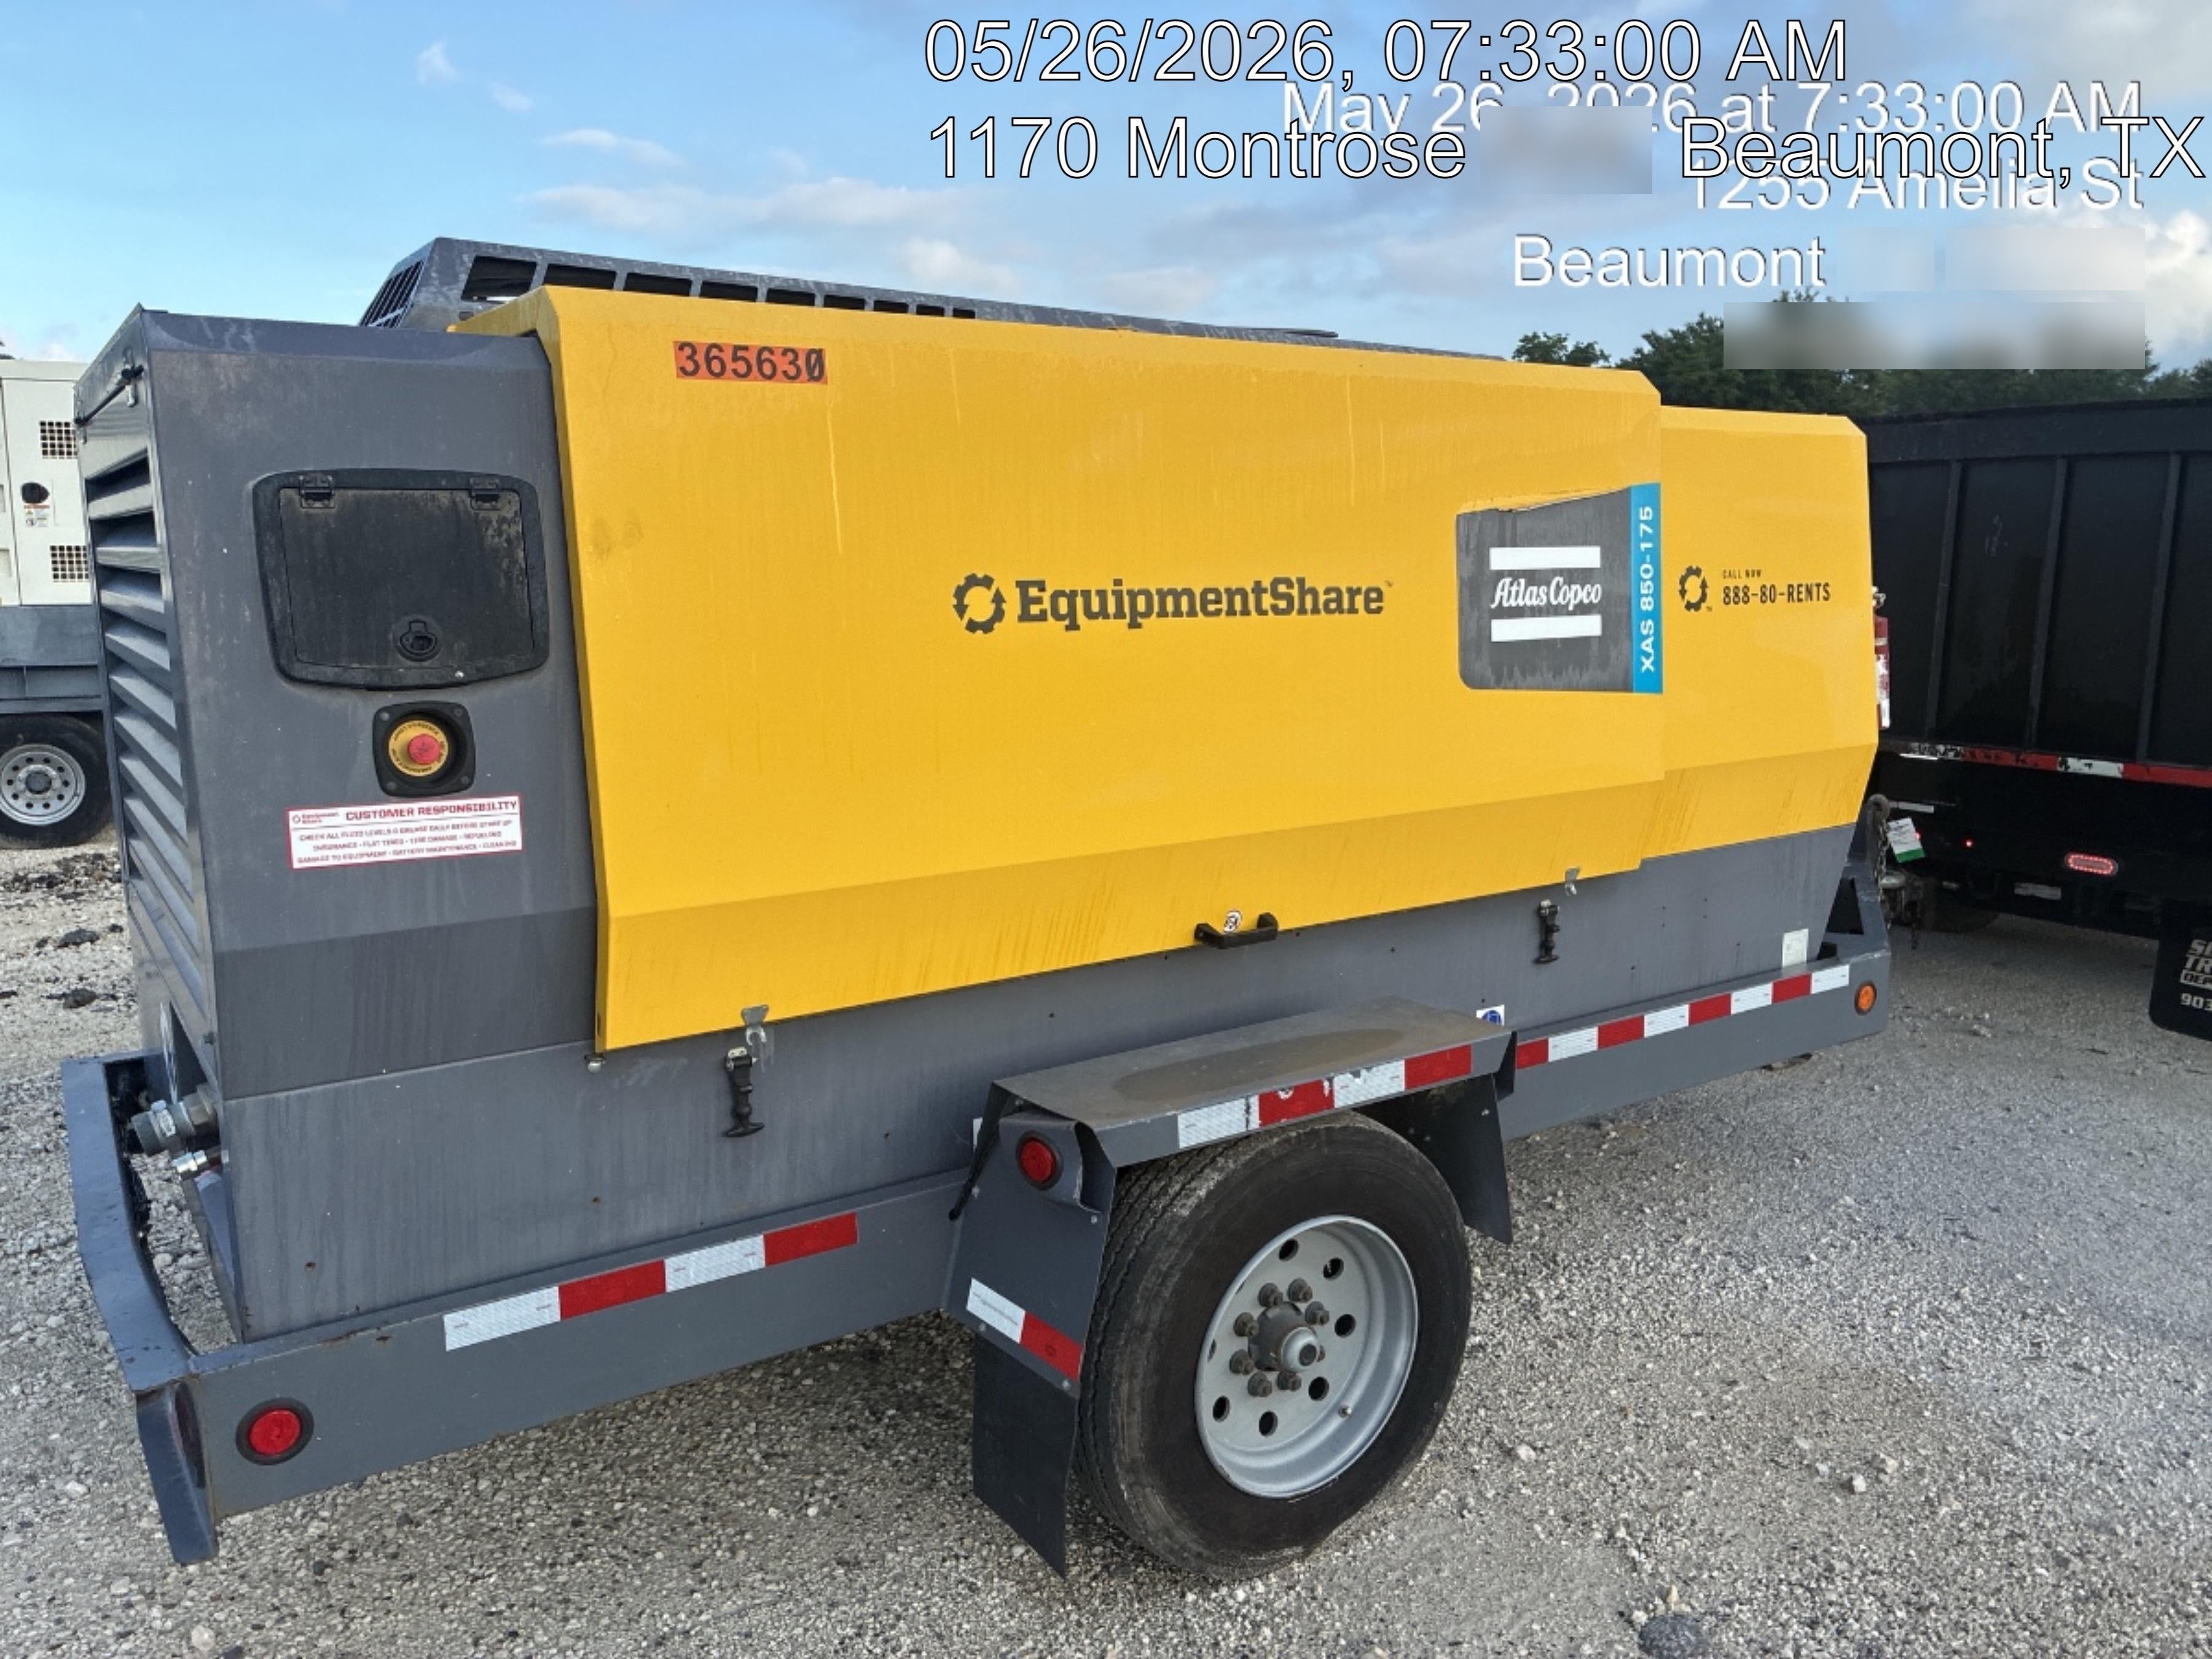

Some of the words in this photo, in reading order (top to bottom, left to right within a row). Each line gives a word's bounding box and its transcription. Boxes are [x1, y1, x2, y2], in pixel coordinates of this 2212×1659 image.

[678, 341, 825, 382] 365630
[1639, 506, 1655, 611] 850-175
[1723, 569, 1742, 579] CALL
[1745, 569, 1762, 579] NOW
[1016, 577, 1384, 631] EquipmentShare
[1490, 576, 1547, 609] Atlas
[1550, 576, 1602, 611] Copco
[1723, 582, 1830, 605] 888-80-RENTS
[1640, 619, 1655, 673] XAS
[346, 807, 414, 821] CUSTOMER
[418, 801, 517, 815] RESPONSIBILITY
